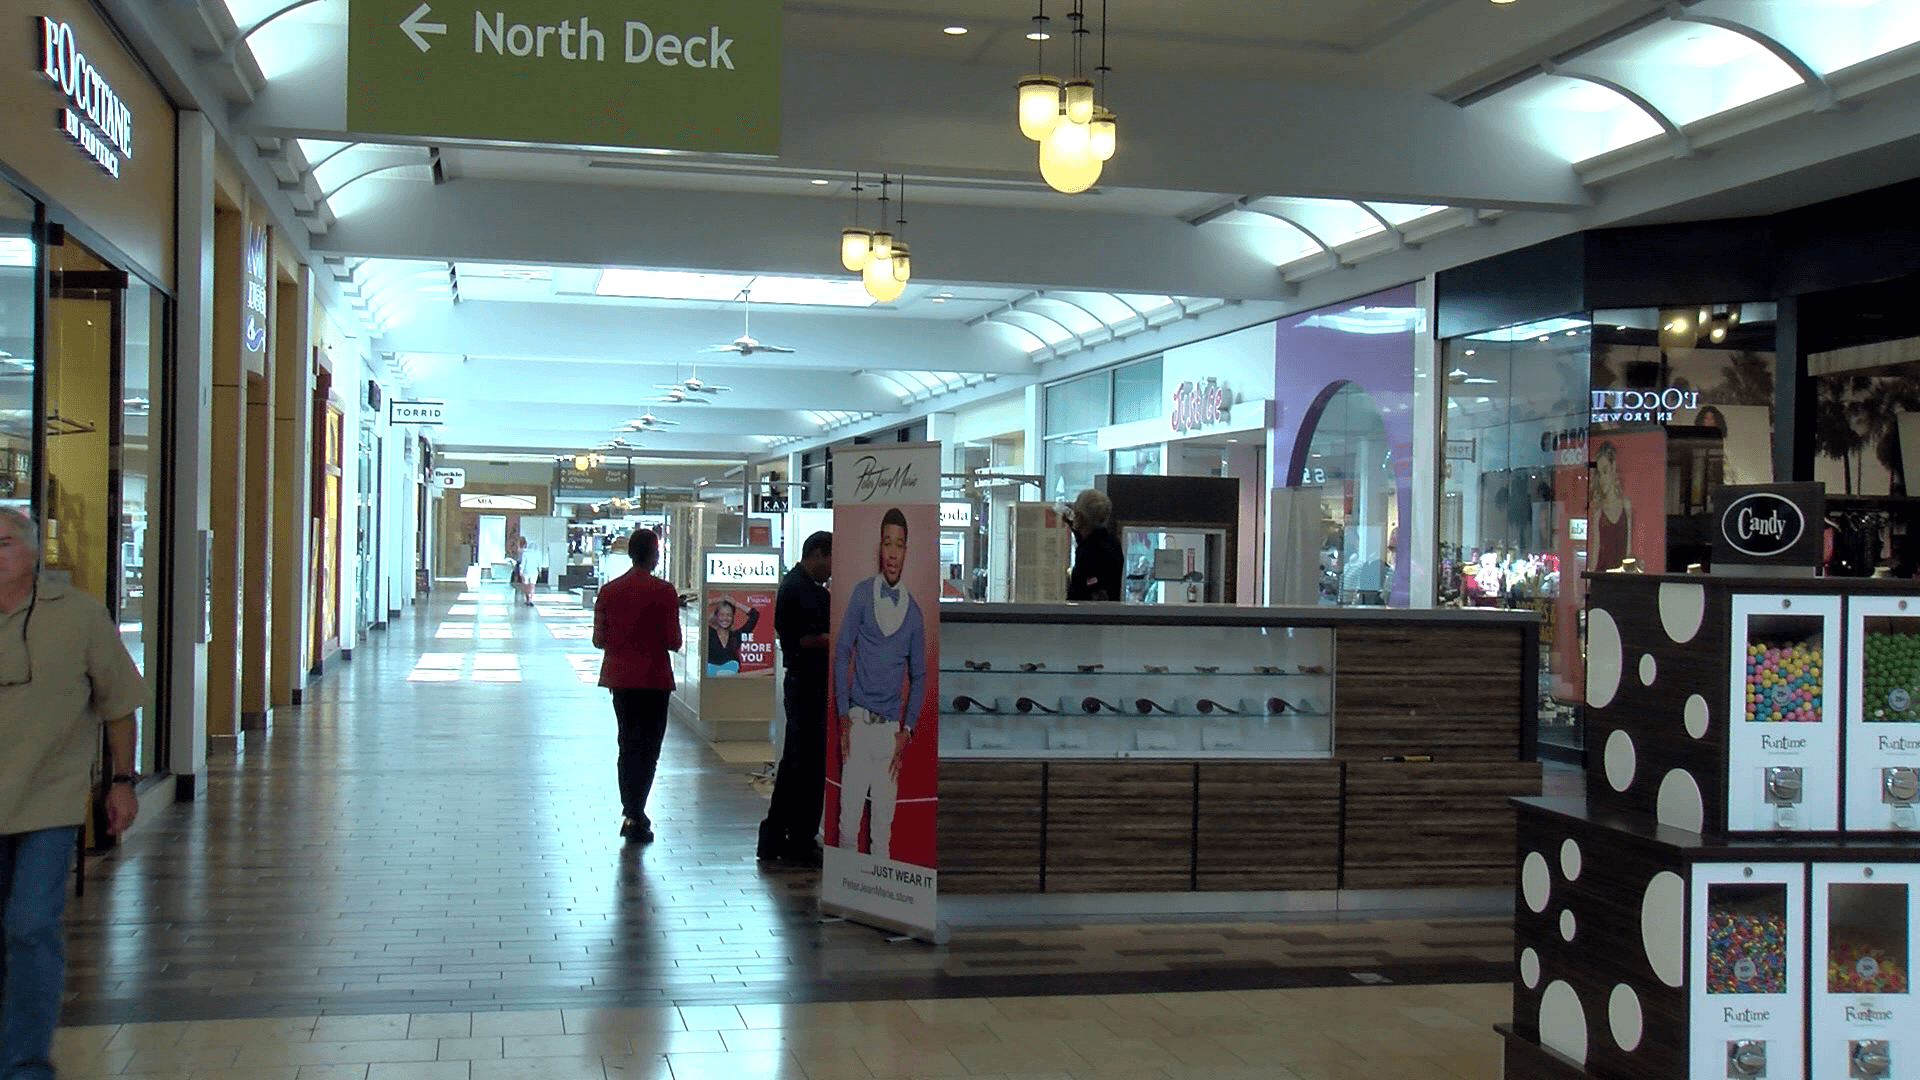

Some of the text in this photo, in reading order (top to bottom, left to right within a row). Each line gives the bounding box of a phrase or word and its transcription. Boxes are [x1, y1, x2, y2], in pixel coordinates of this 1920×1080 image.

[474, 10, 735, 70] North Deck
[65, 108, 79, 139] EN
[396, 408, 442, 418] TORRID
[763, 501, 788, 509] KAY
[1737, 506, 1787, 540] Candy
[710, 559, 775, 580] Pagoda
[741, 632, 754, 642] BE
[741, 643, 772, 652] MORE
[741, 653, 764, 662] YOU
[1761, 734, 1807, 750] Funtime
[871, 864, 932, 888] JUST WEAR IT
[1723, 1006, 1770, 1023] Funtime
[1844, 1006, 1893, 1022] Funtime
